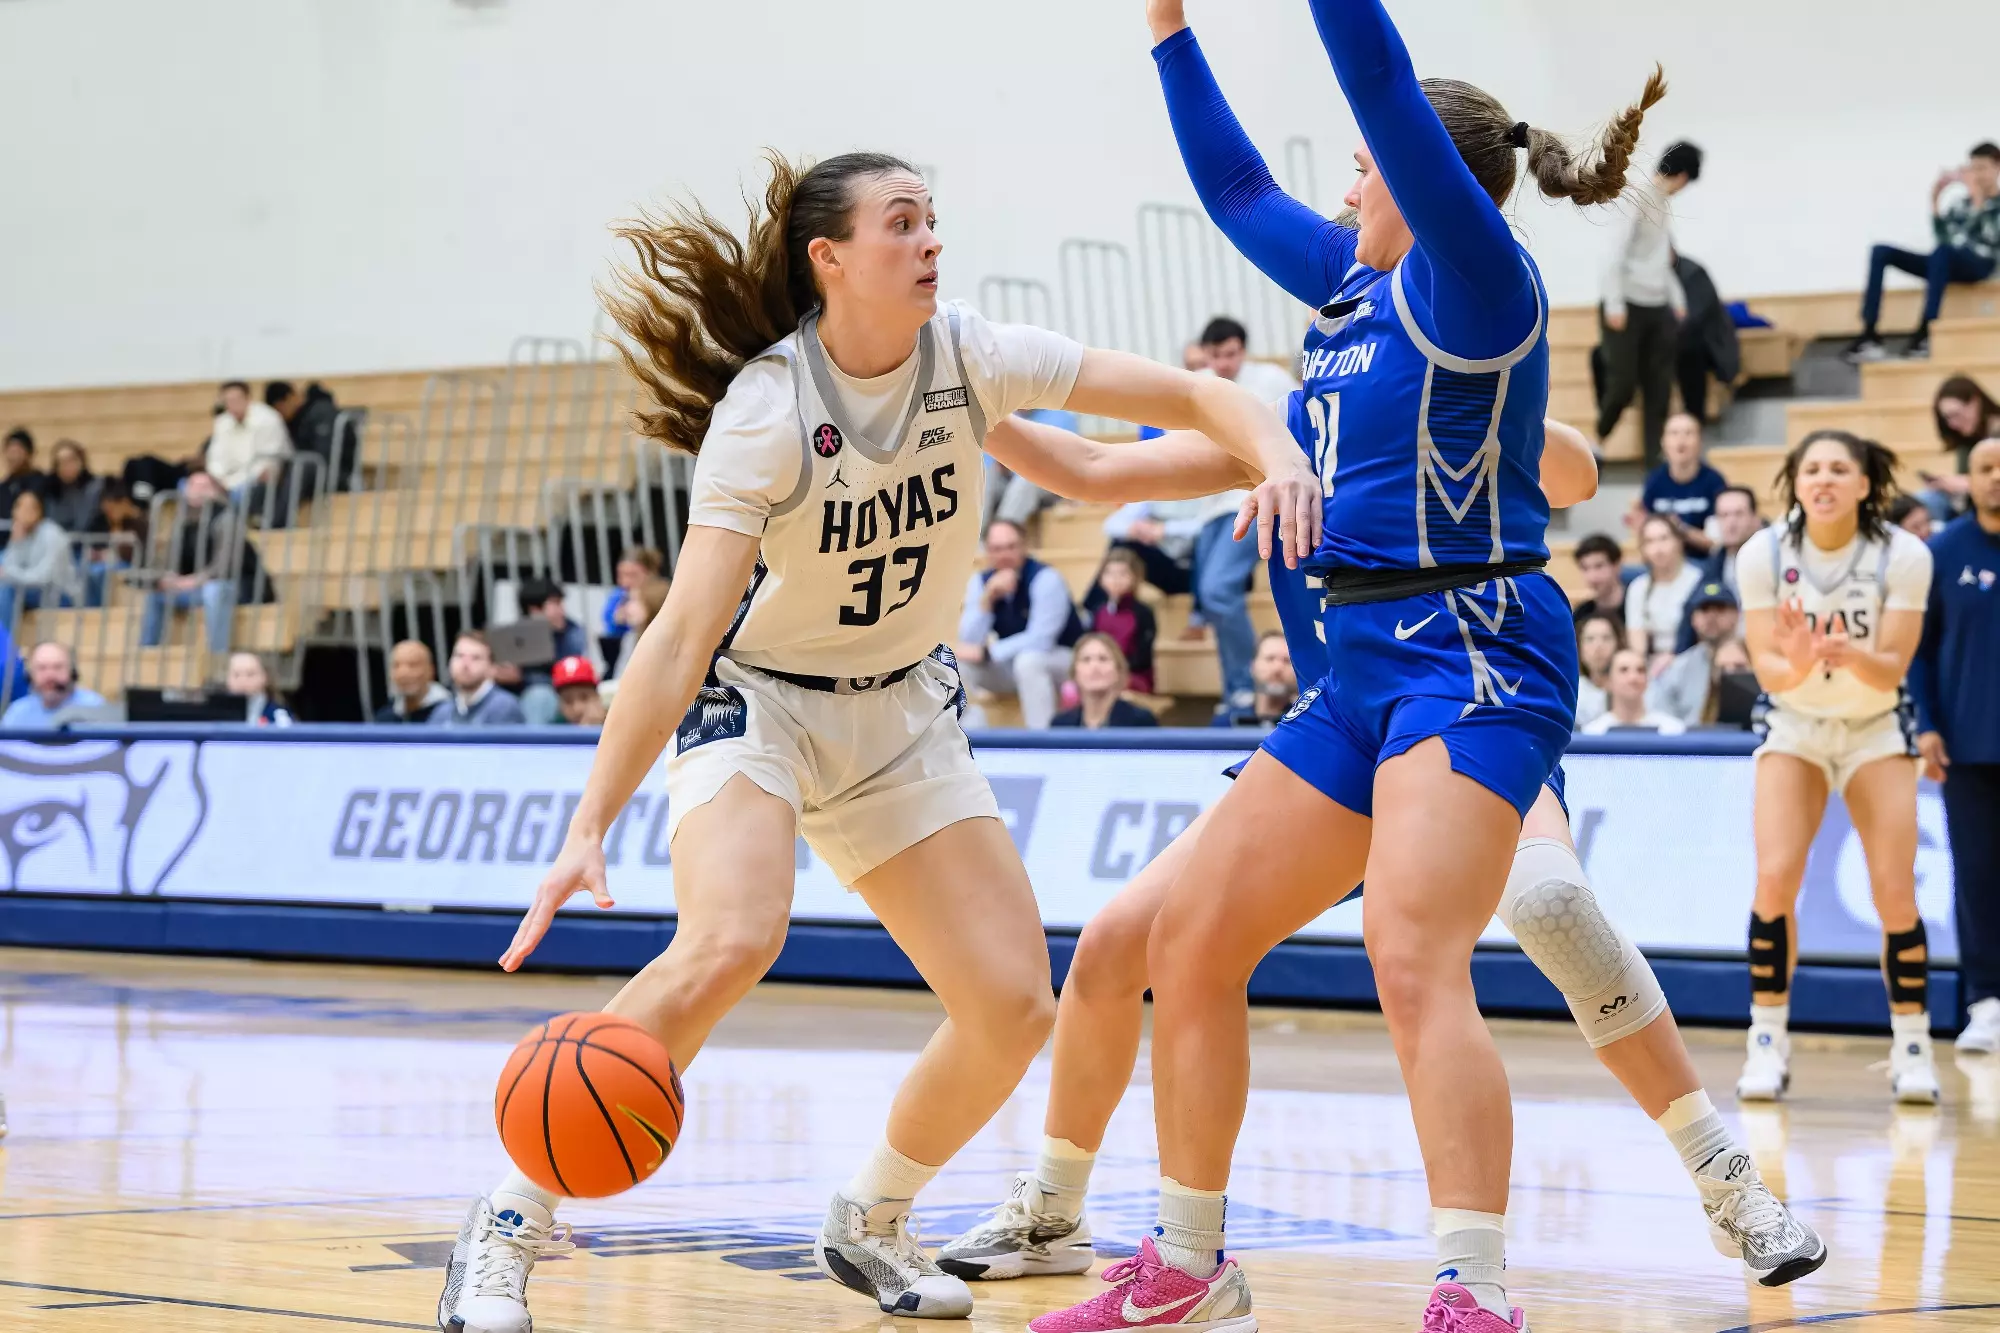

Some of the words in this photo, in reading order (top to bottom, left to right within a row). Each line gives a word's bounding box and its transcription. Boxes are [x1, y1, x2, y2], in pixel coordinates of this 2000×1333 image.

[926, 398, 967, 411] CHANGE
[918, 432, 954, 449] EAST
[921, 426, 946, 439] BIG
[819, 463, 958, 554] HOYAS
[839, 543, 930, 627] 33
